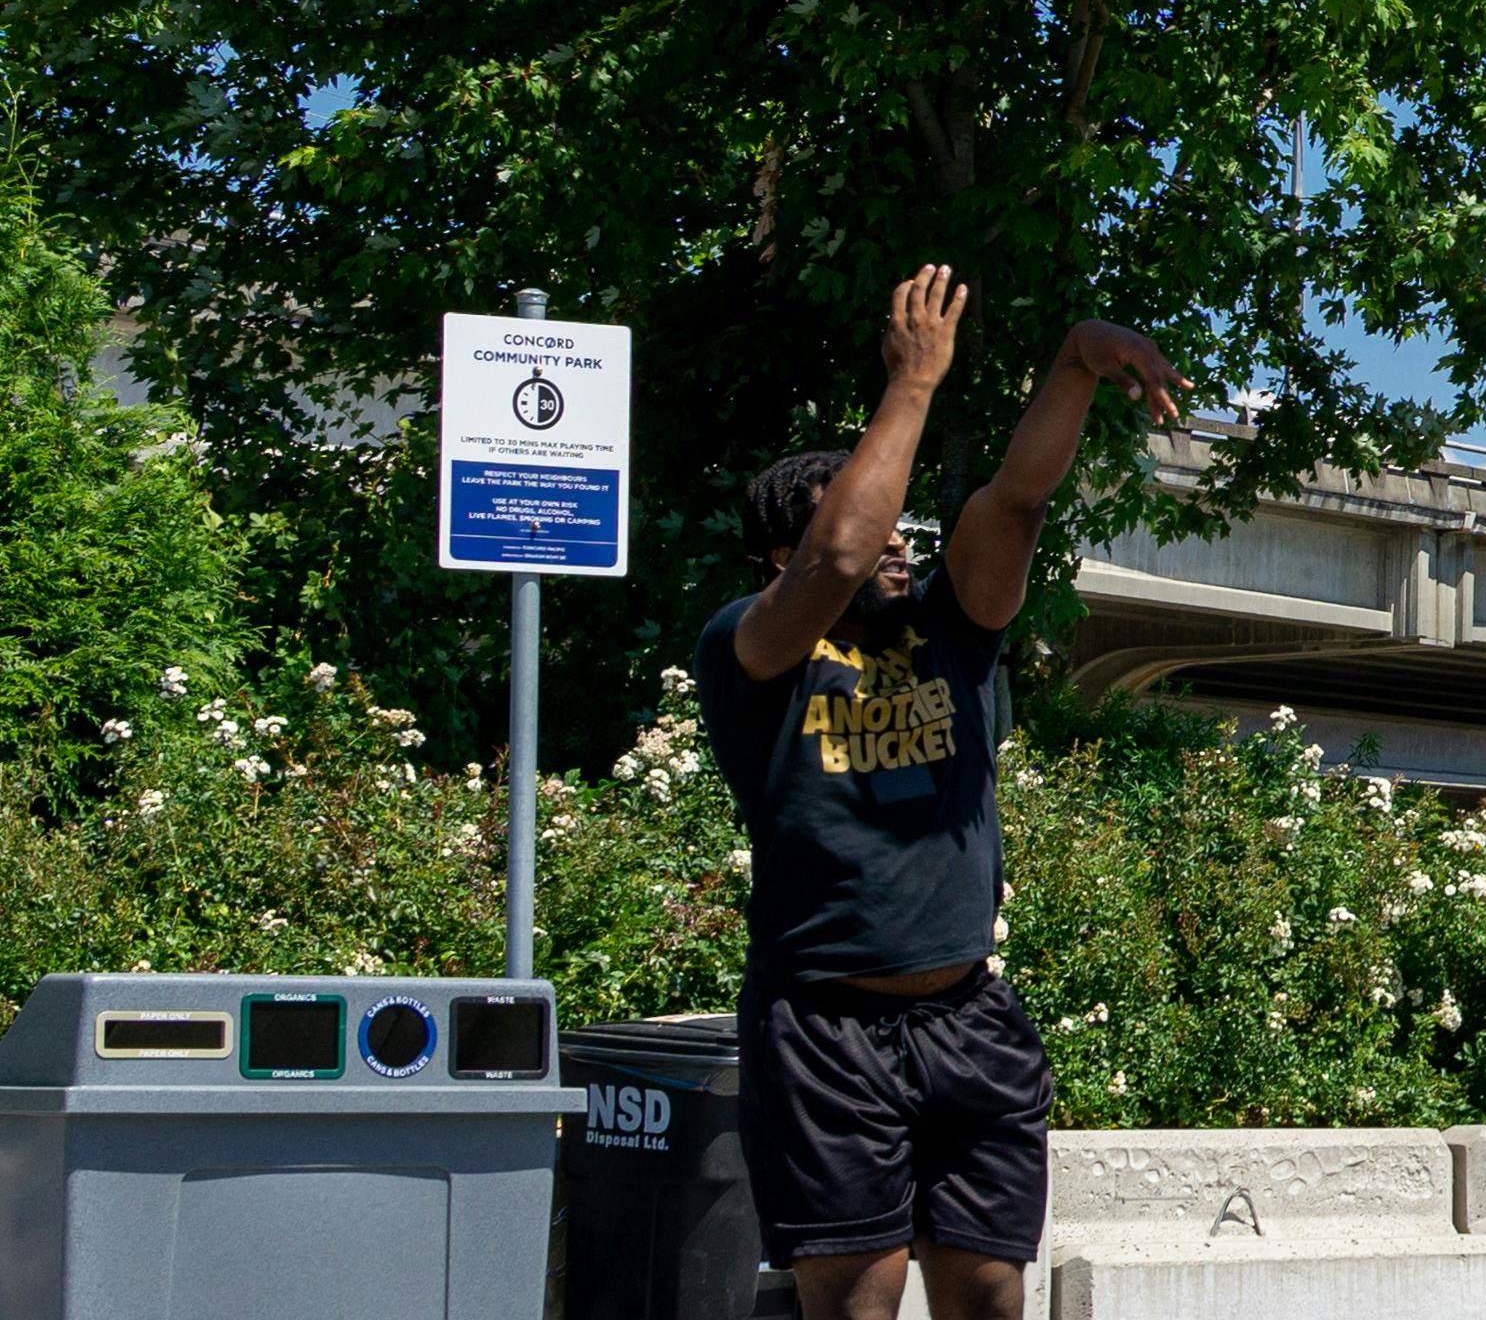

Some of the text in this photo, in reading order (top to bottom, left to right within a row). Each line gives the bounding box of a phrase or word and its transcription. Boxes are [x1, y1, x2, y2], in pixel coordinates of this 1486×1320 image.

[474, 350, 603, 370] COMMUNITY PARK
[540, 399, 555, 411] 30
[460, 436, 492, 444] LIMITED
[520, 440, 539, 448] MINS
[560, 442, 593, 451] PLAYING
[498, 447, 529, 455] OTHERS
[549, 450, 584, 459] WAITING
[484, 470, 517, 479] RESPECT
[518, 472, 538, 480] YOUR
[462, 477, 485, 485] LEAVE
[487, 478, 501, 486] THE
[503, 479, 522, 487] PARK
[524, 480, 539, 488] THE
[558, 482, 573, 490] YOU
[520, 499, 540, 507] YOUR
[561, 501, 578, 509] RISK
[802, 677, 957, 735] ANOTHER
[821, 717, 956, 773] BUCKET
[274, 994, 317, 1002] ORGANICS
[487, 996, 515, 1004] WASTE
[367, 998, 389, 1018] CANS
[396, 996, 431, 1018] BOTTLES
[140, 1012, 192, 1020] PAPER ONLY
[367, 1055, 386, 1074] CANS
[393, 1055, 429, 1077] BOTTLES
[272, 1070, 315, 1078] ORGANICS
[486, 1071, 513, 1079] WASTE
[587, 1083, 671, 1134] NSD
[586, 1131, 670, 1151] Disposal Ltd.
